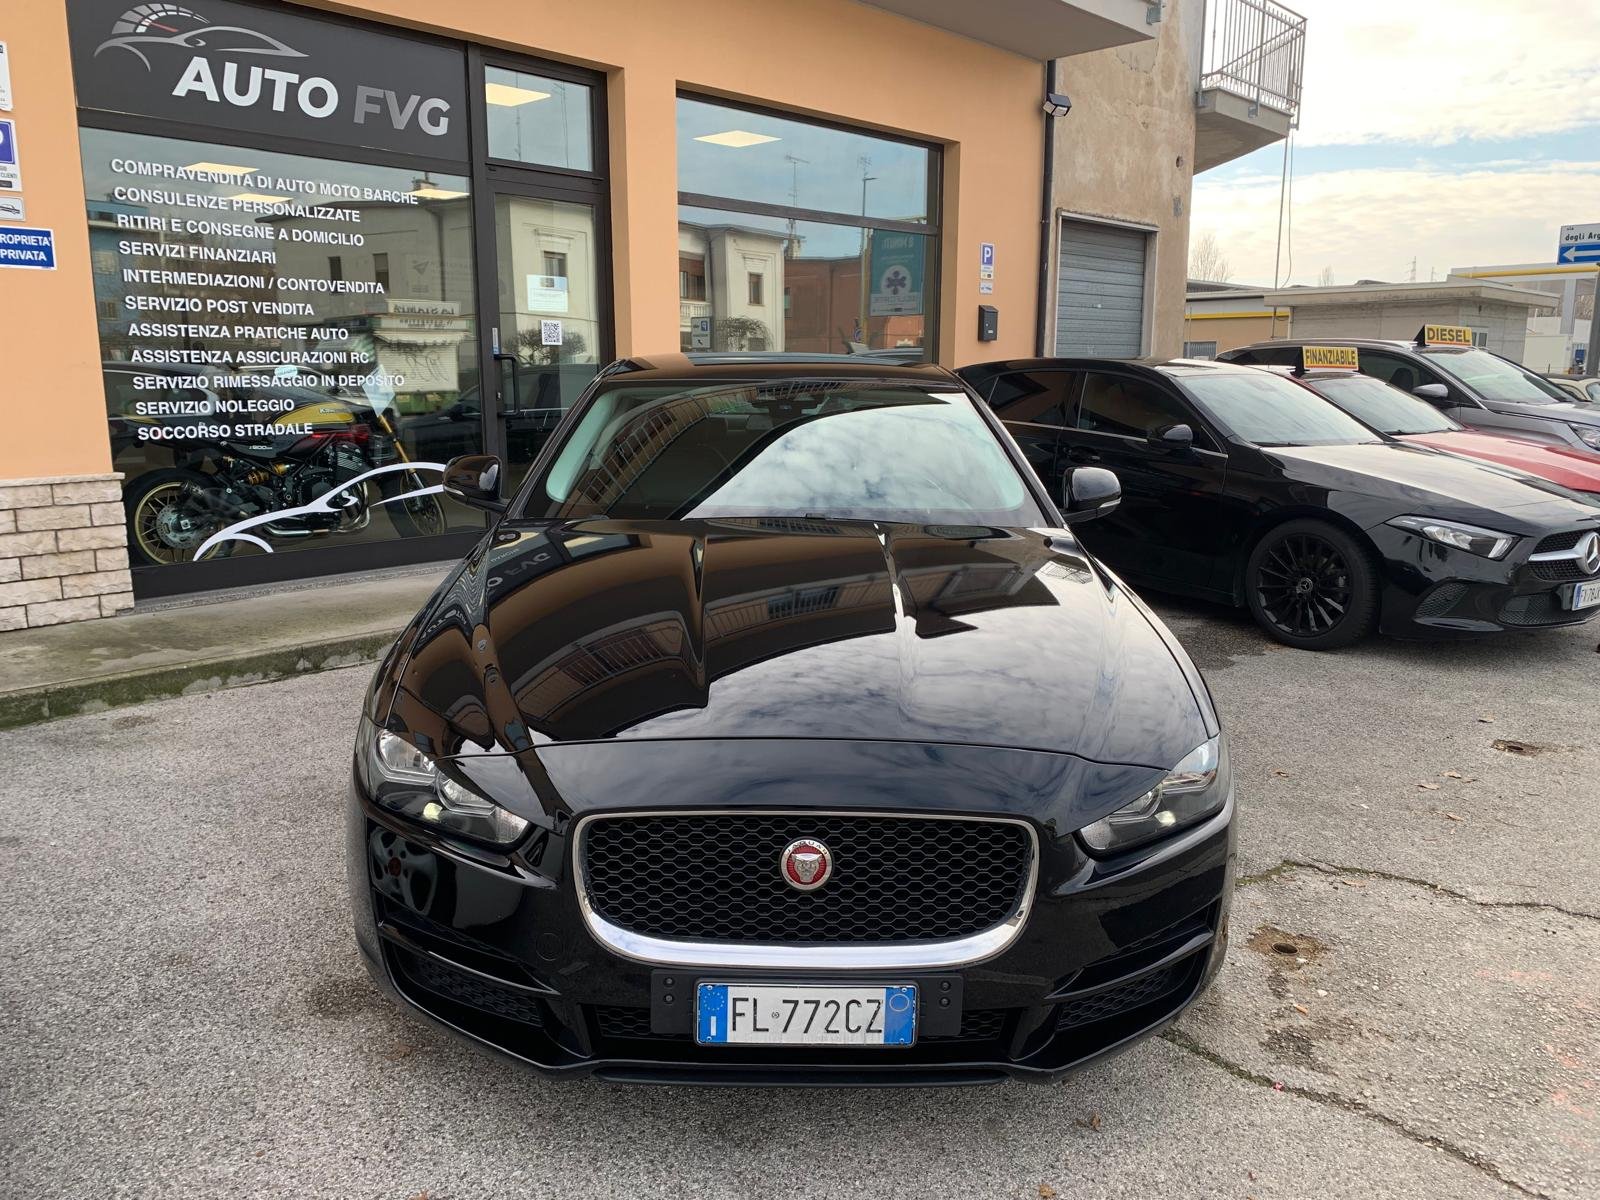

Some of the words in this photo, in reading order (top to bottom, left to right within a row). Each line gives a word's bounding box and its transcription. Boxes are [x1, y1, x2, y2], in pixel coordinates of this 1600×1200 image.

[172, 56, 339, 118] AUTO
[353, 85, 450, 136] FVG
[111, 158, 253, 187] COMPRAVENDITA
[257, 175, 272, 189] DI
[276, 178, 316, 194] AUTO
[320, 183, 361, 199] MOTO
[364, 188, 419, 205] BARCHE
[114, 187, 229, 211] CONSULENZE
[233, 200, 361, 223] PERSONALIZZATE
[117, 214, 167, 231] RITIRI
[171, 219, 182, 232] E
[186, 220, 275, 240] CONSEGNE
[278, 228, 290, 241] A
[292, 230, 364, 247] DOMICILIO
[1565, 232, 1585, 242] degli
[0, 249, 47, 262] PRIVATA
[119, 241, 185, 258] SERVIZI
[189, 246, 277, 264] FINANZIARI
[983, 246, 992, 263] P
[122, 268, 265, 289] INTERMEDIAZIONI
[277, 276, 385, 294] CONTOVENDITA
[125, 296, 203, 312] SERVIZIO
[206, 299, 248, 314] POST
[252, 301, 315, 316] VENDITA
[128, 323, 231, 338] ASSISTENZA
[234, 326, 308, 340] PRATICHE
[311, 327, 349, 341] AUTO
[1426, 326, 1471, 343] DIESEL
[131, 350, 233, 364] ASSISTENZA
[236, 350, 347, 364] ASSICURAZIONI
[350, 351, 370, 364] RC
[1305, 348, 1356, 365] FINANZIABILE
[133, 375, 209, 390] SERVIZIO
[213, 374, 317, 388] RIMESSAGGIO
[320, 375, 335, 387] IN
[338, 375, 405, 387] DEPOSITO
[135, 400, 211, 415] SERVIZIO
[215, 398, 295, 413] NOLEGGIO
[138, 425, 231, 441] SOCCORSO
[234, 422, 314, 438] STRADALE
